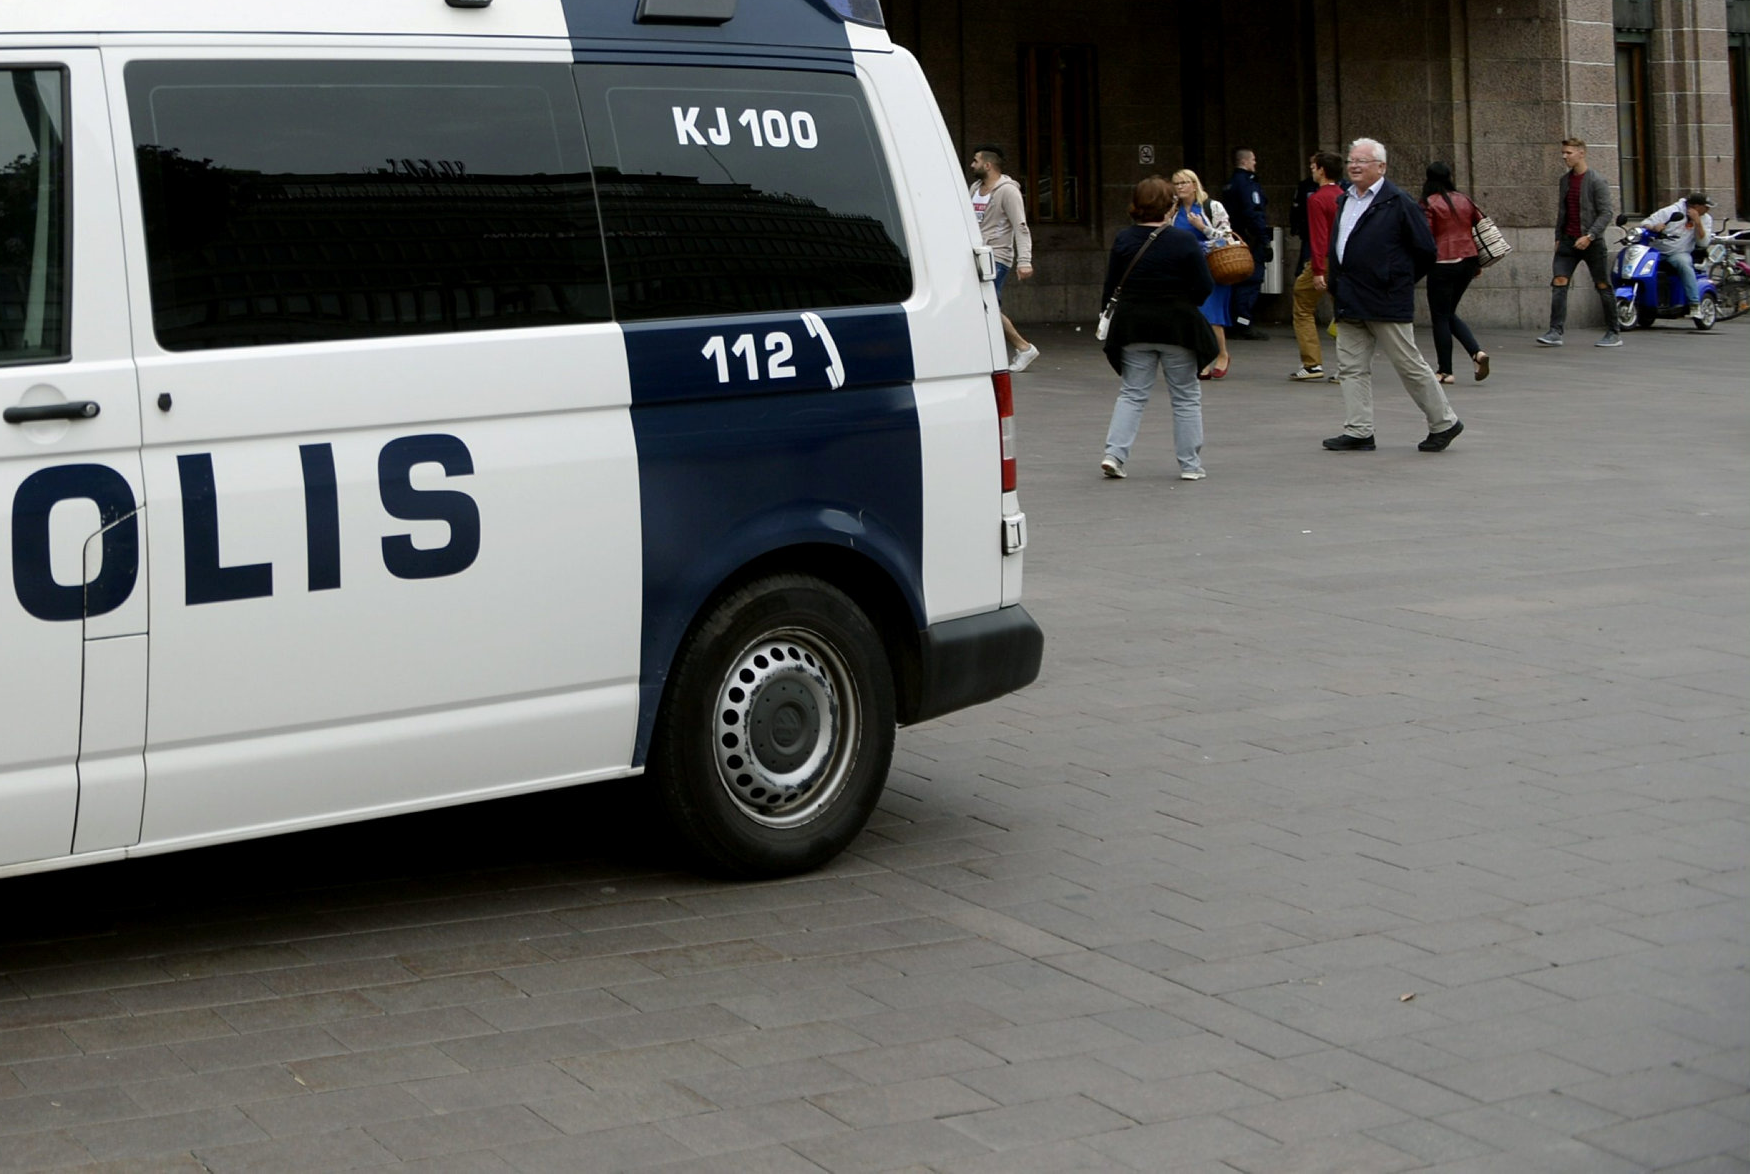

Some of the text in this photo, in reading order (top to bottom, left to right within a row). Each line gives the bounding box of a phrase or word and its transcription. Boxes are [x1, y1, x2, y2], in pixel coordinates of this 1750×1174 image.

[672, 106, 818, 149] KJ 100
[701, 331, 797, 383] 112
